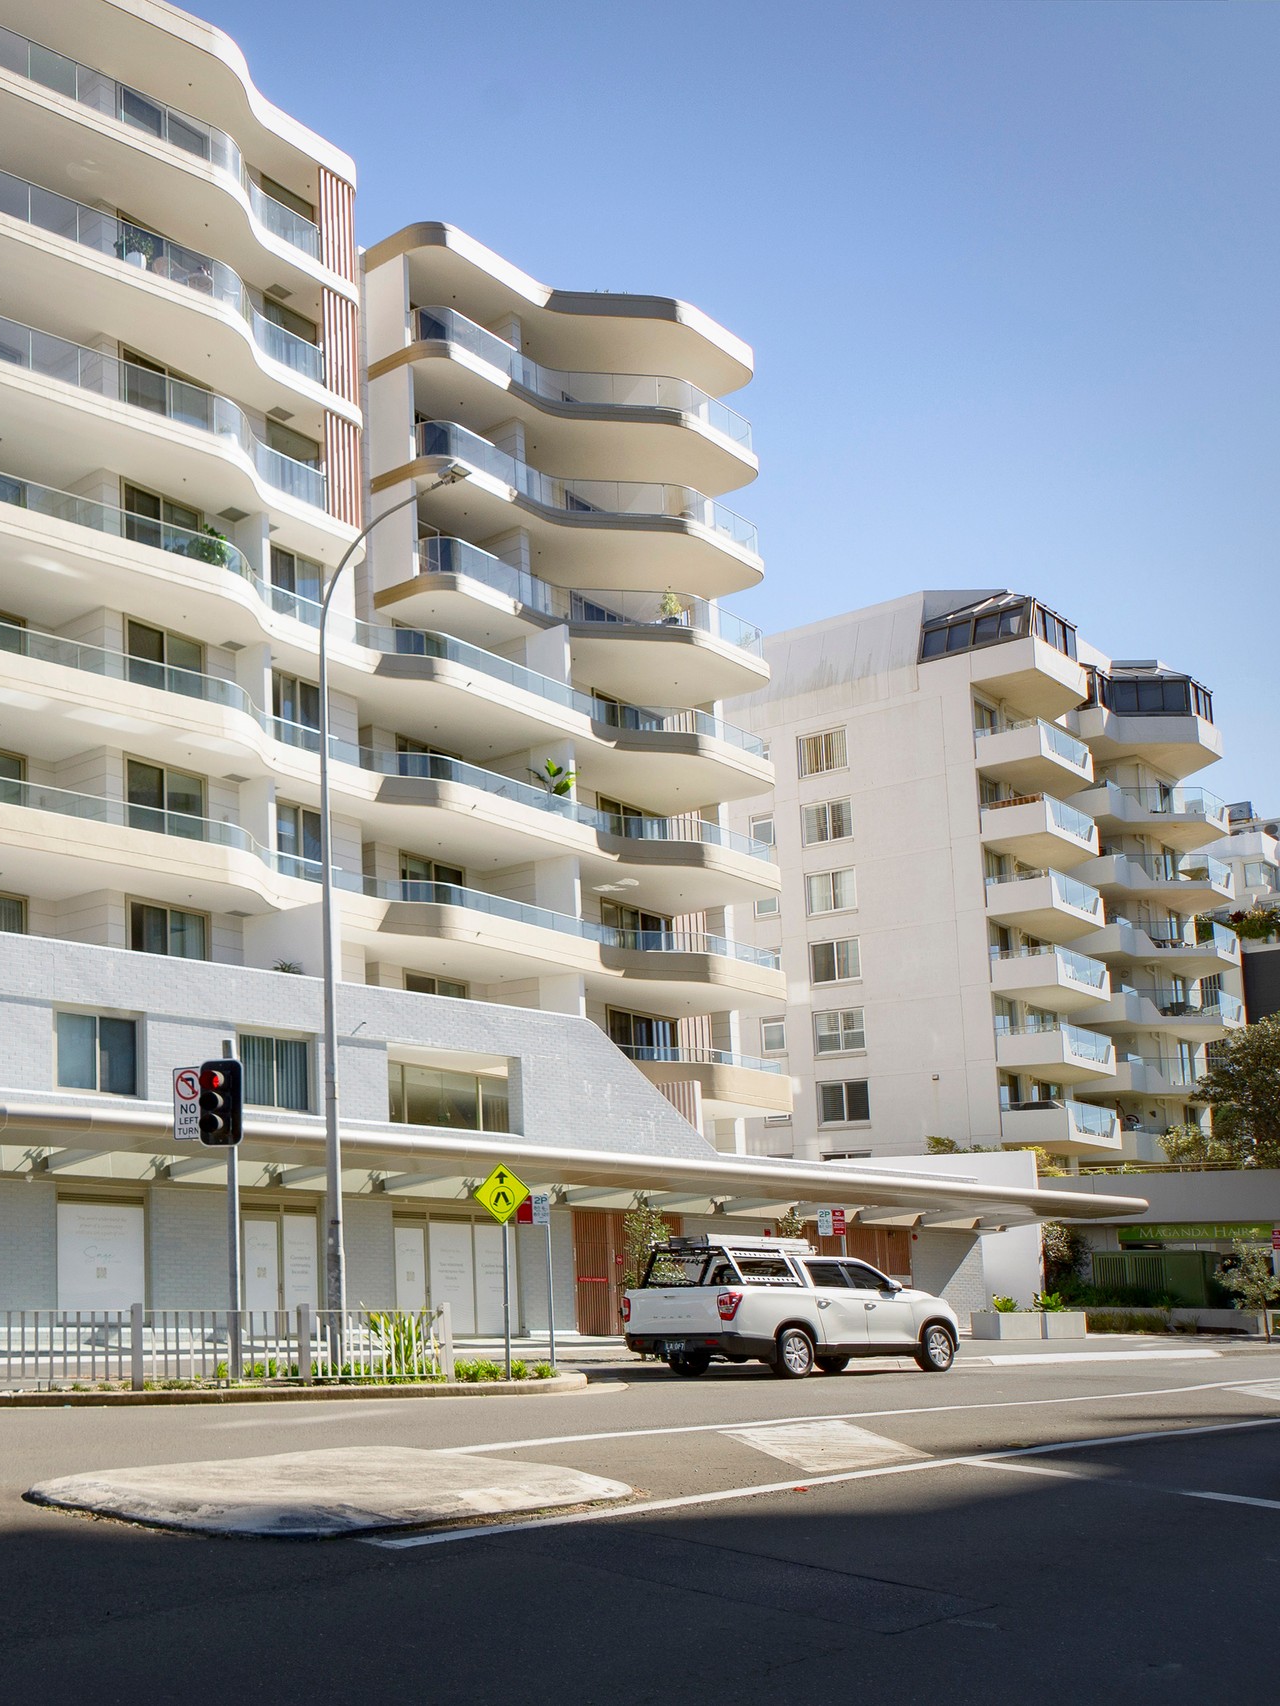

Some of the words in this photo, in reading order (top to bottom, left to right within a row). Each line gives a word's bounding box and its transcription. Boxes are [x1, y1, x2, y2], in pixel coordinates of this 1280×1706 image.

[180, 1104, 197, 1114] NO
[179, 1117, 199, 1125] LEFT
[533, 1196, 548, 1205] 2P
[1139, 1227, 1209, 1238] MAGANDA
[1214, 1226, 1250, 1237] HAIR
